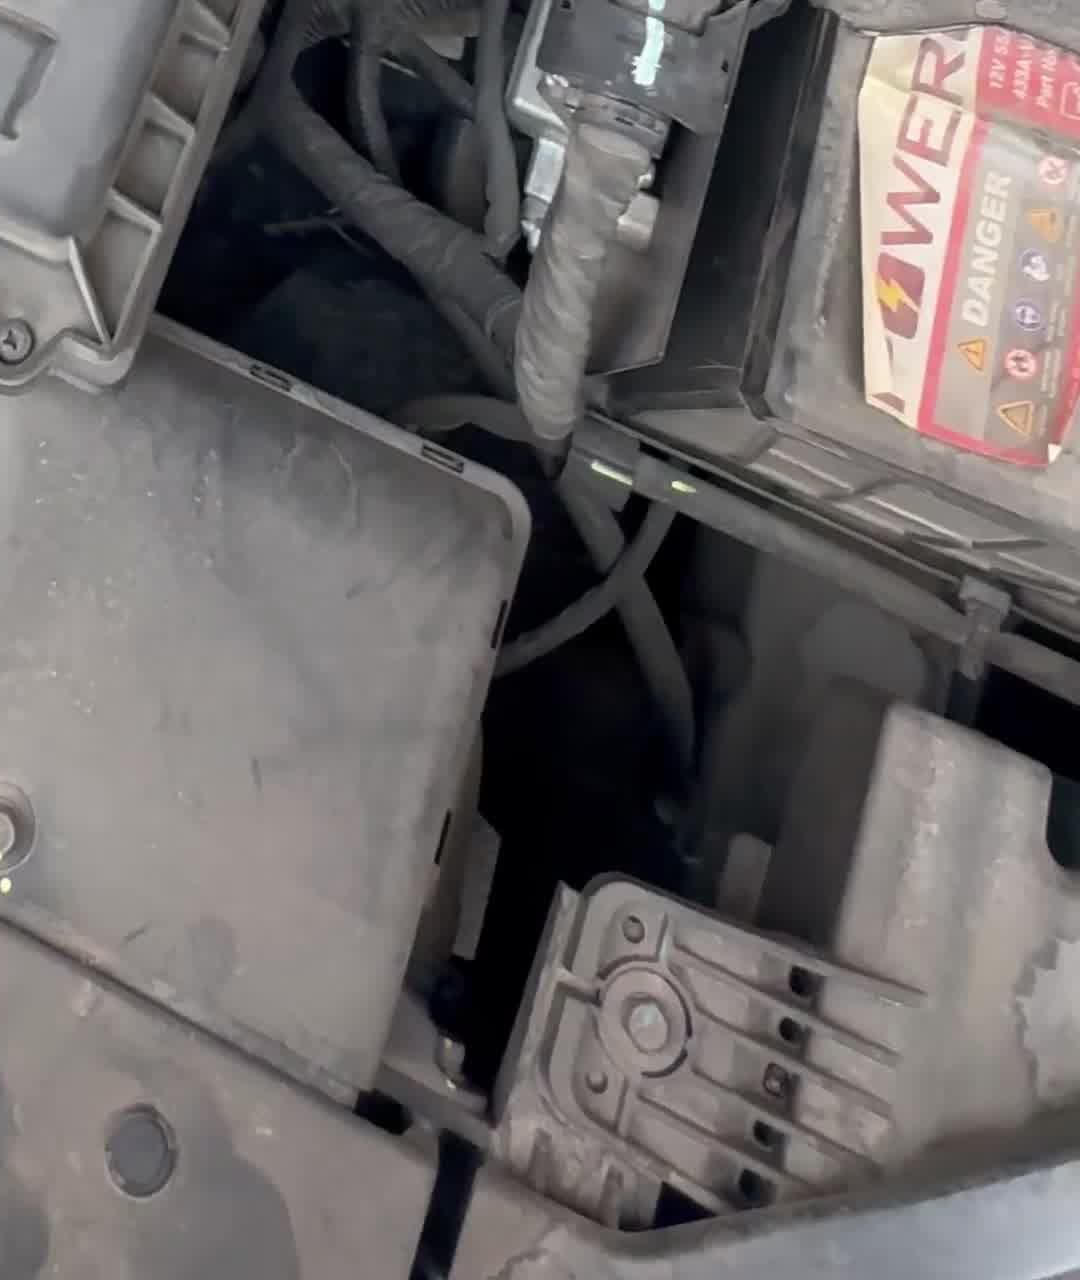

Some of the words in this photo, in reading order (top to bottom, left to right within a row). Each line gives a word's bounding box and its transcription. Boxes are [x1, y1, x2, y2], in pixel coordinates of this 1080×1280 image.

[988, 57, 1006, 89] 12V
[1036, 74, 1054, 108] Part
[962, 172, 1011, 327] DANGER
